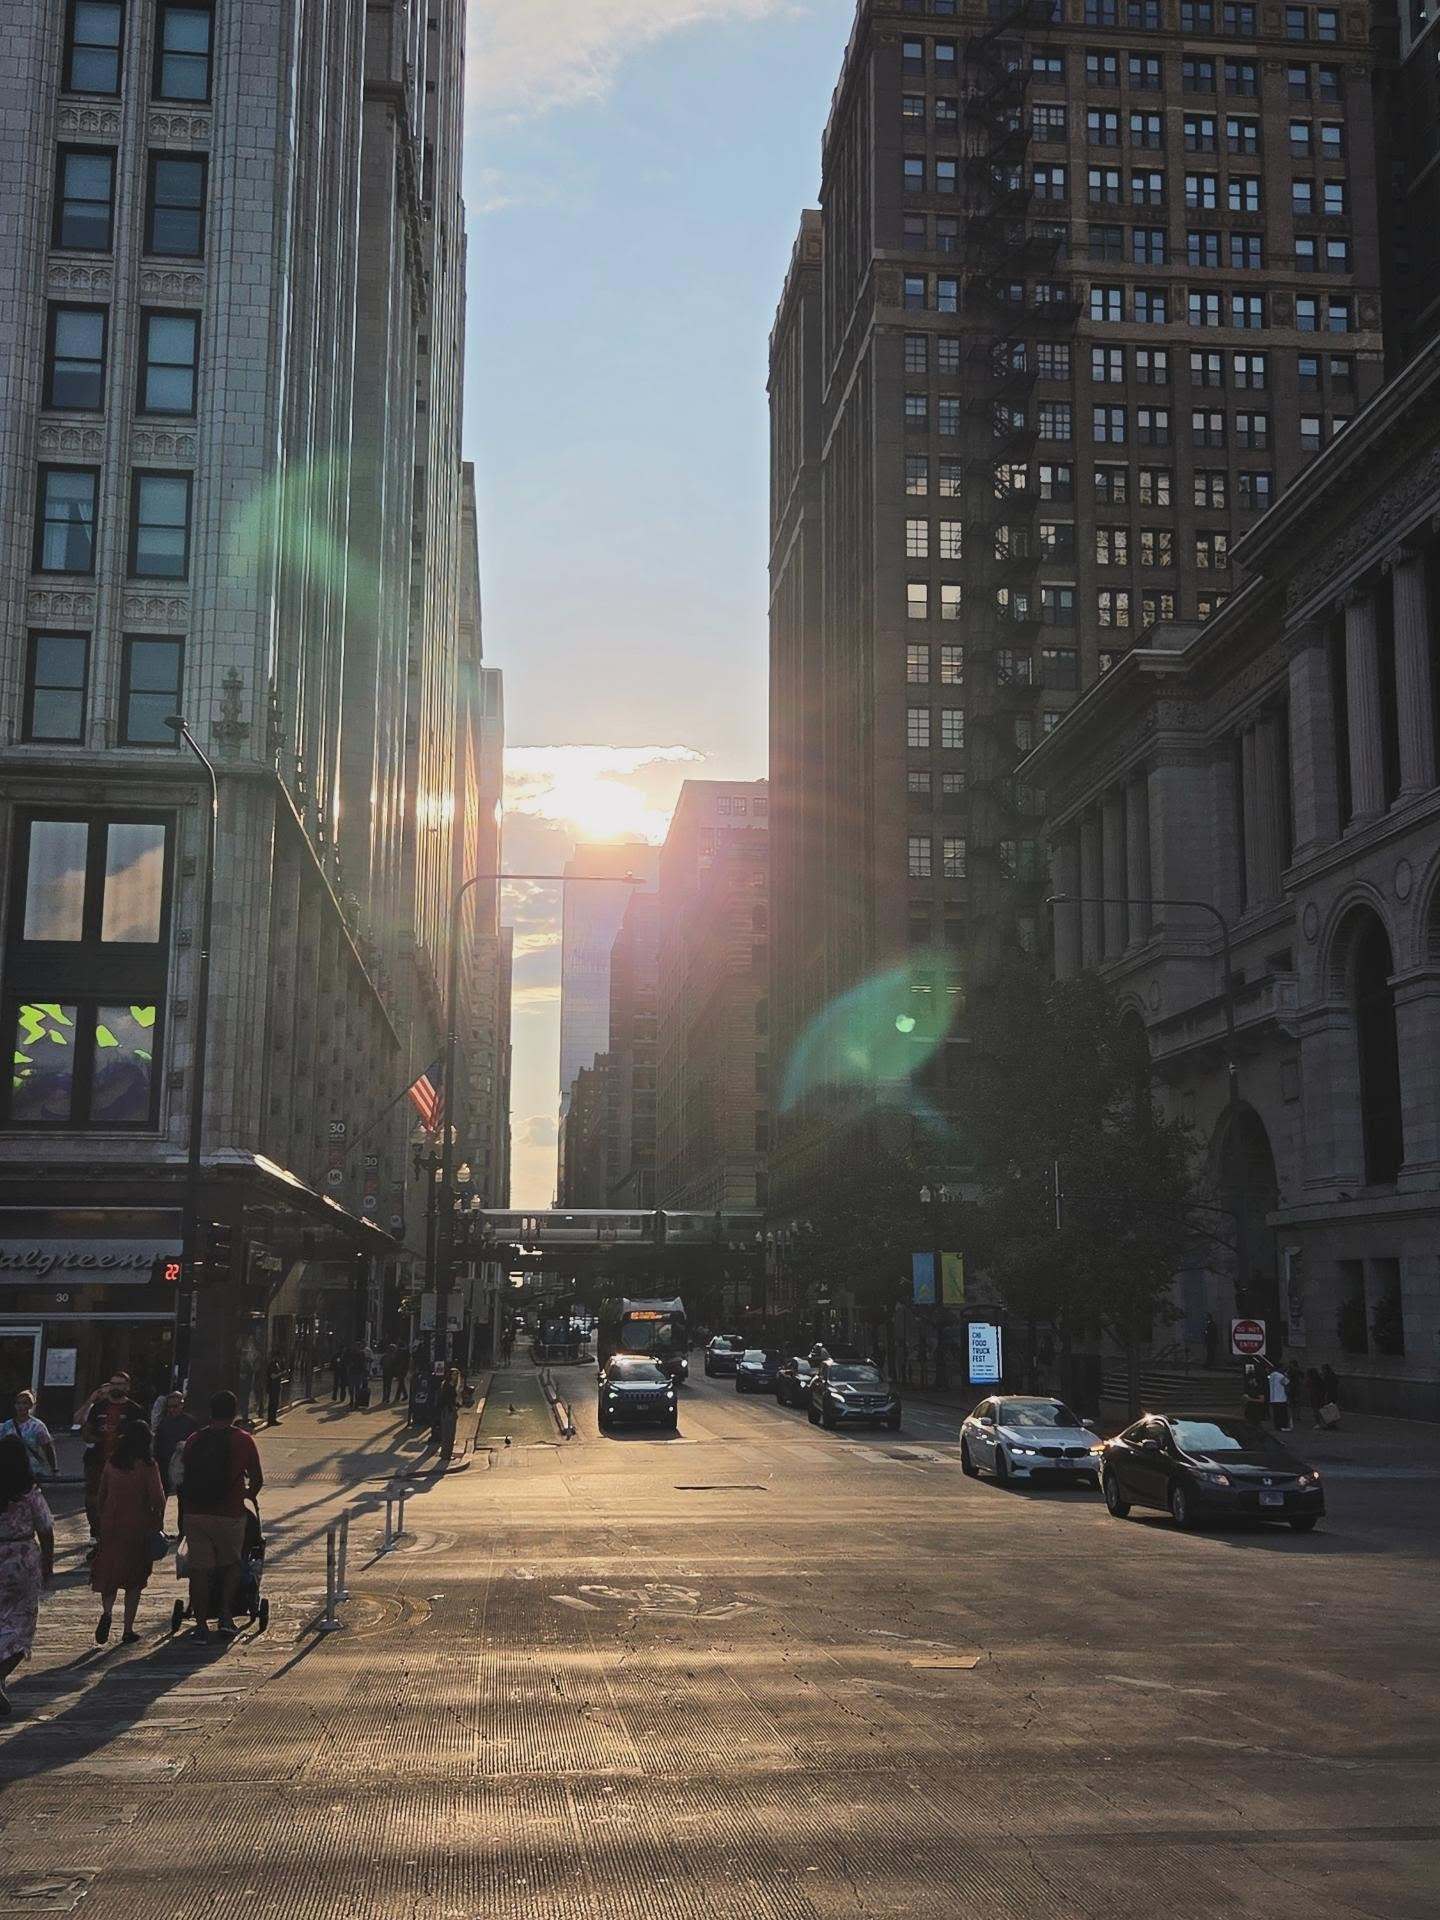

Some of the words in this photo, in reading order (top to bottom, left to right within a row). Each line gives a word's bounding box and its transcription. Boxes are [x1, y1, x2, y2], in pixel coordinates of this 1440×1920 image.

[330, 1122, 345, 1133] 30
[0, 1247, 159, 1276] algreens
[165, 1263, 180, 1280] 22
[56, 1293, 69, 1302] 30
